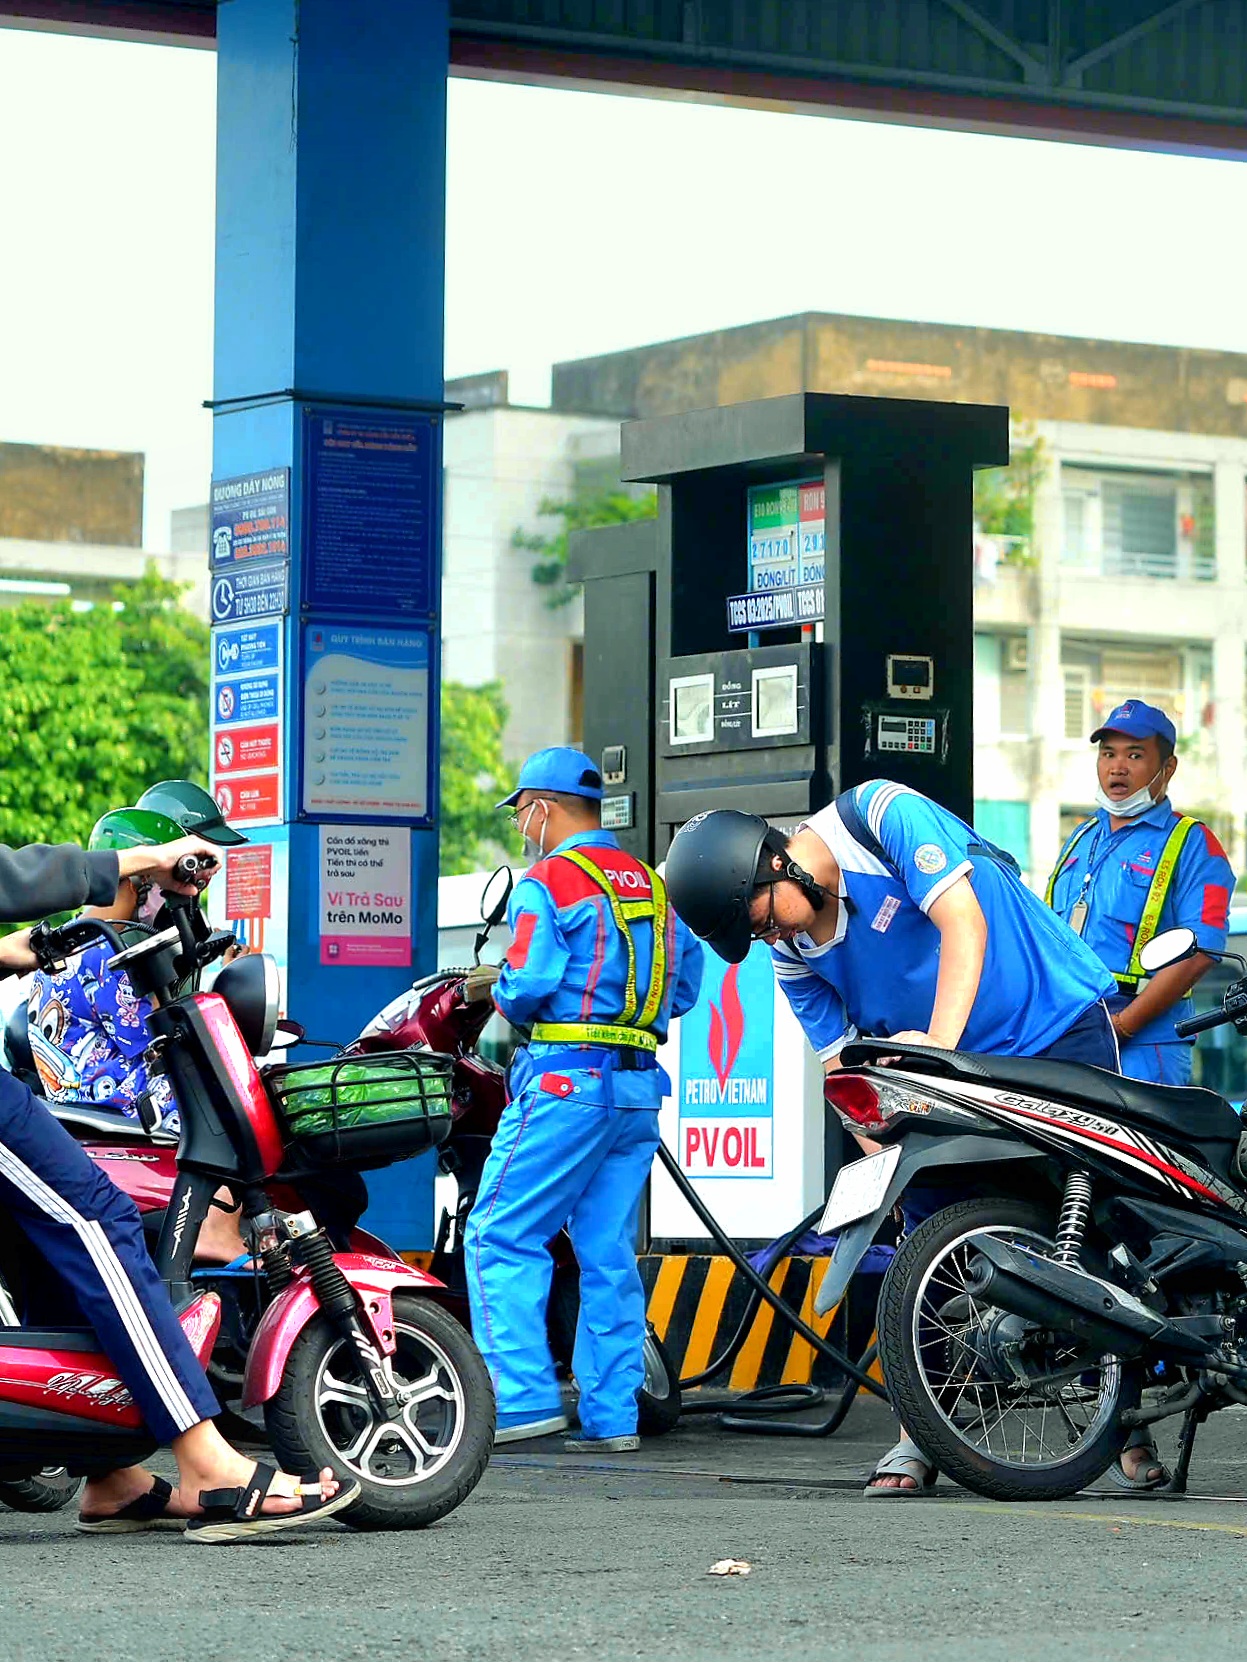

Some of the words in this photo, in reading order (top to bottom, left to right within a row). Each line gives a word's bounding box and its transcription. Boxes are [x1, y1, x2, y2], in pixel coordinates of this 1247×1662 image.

[753, 538, 788, 559] 27170
[729, 599, 746, 626] TCCS
[1155, 870, 1167, 890] RON
[345, 891, 370, 907] Trả
[374, 892, 404, 907] Sau
[327, 911, 355, 923] trên
[359, 912, 403, 924] MoMo
[685, 1078, 767, 1104] PETROVIETNAM
[994, 1092, 1094, 1127] Galaxy
[686, 1127, 765, 1167] PVOIL
